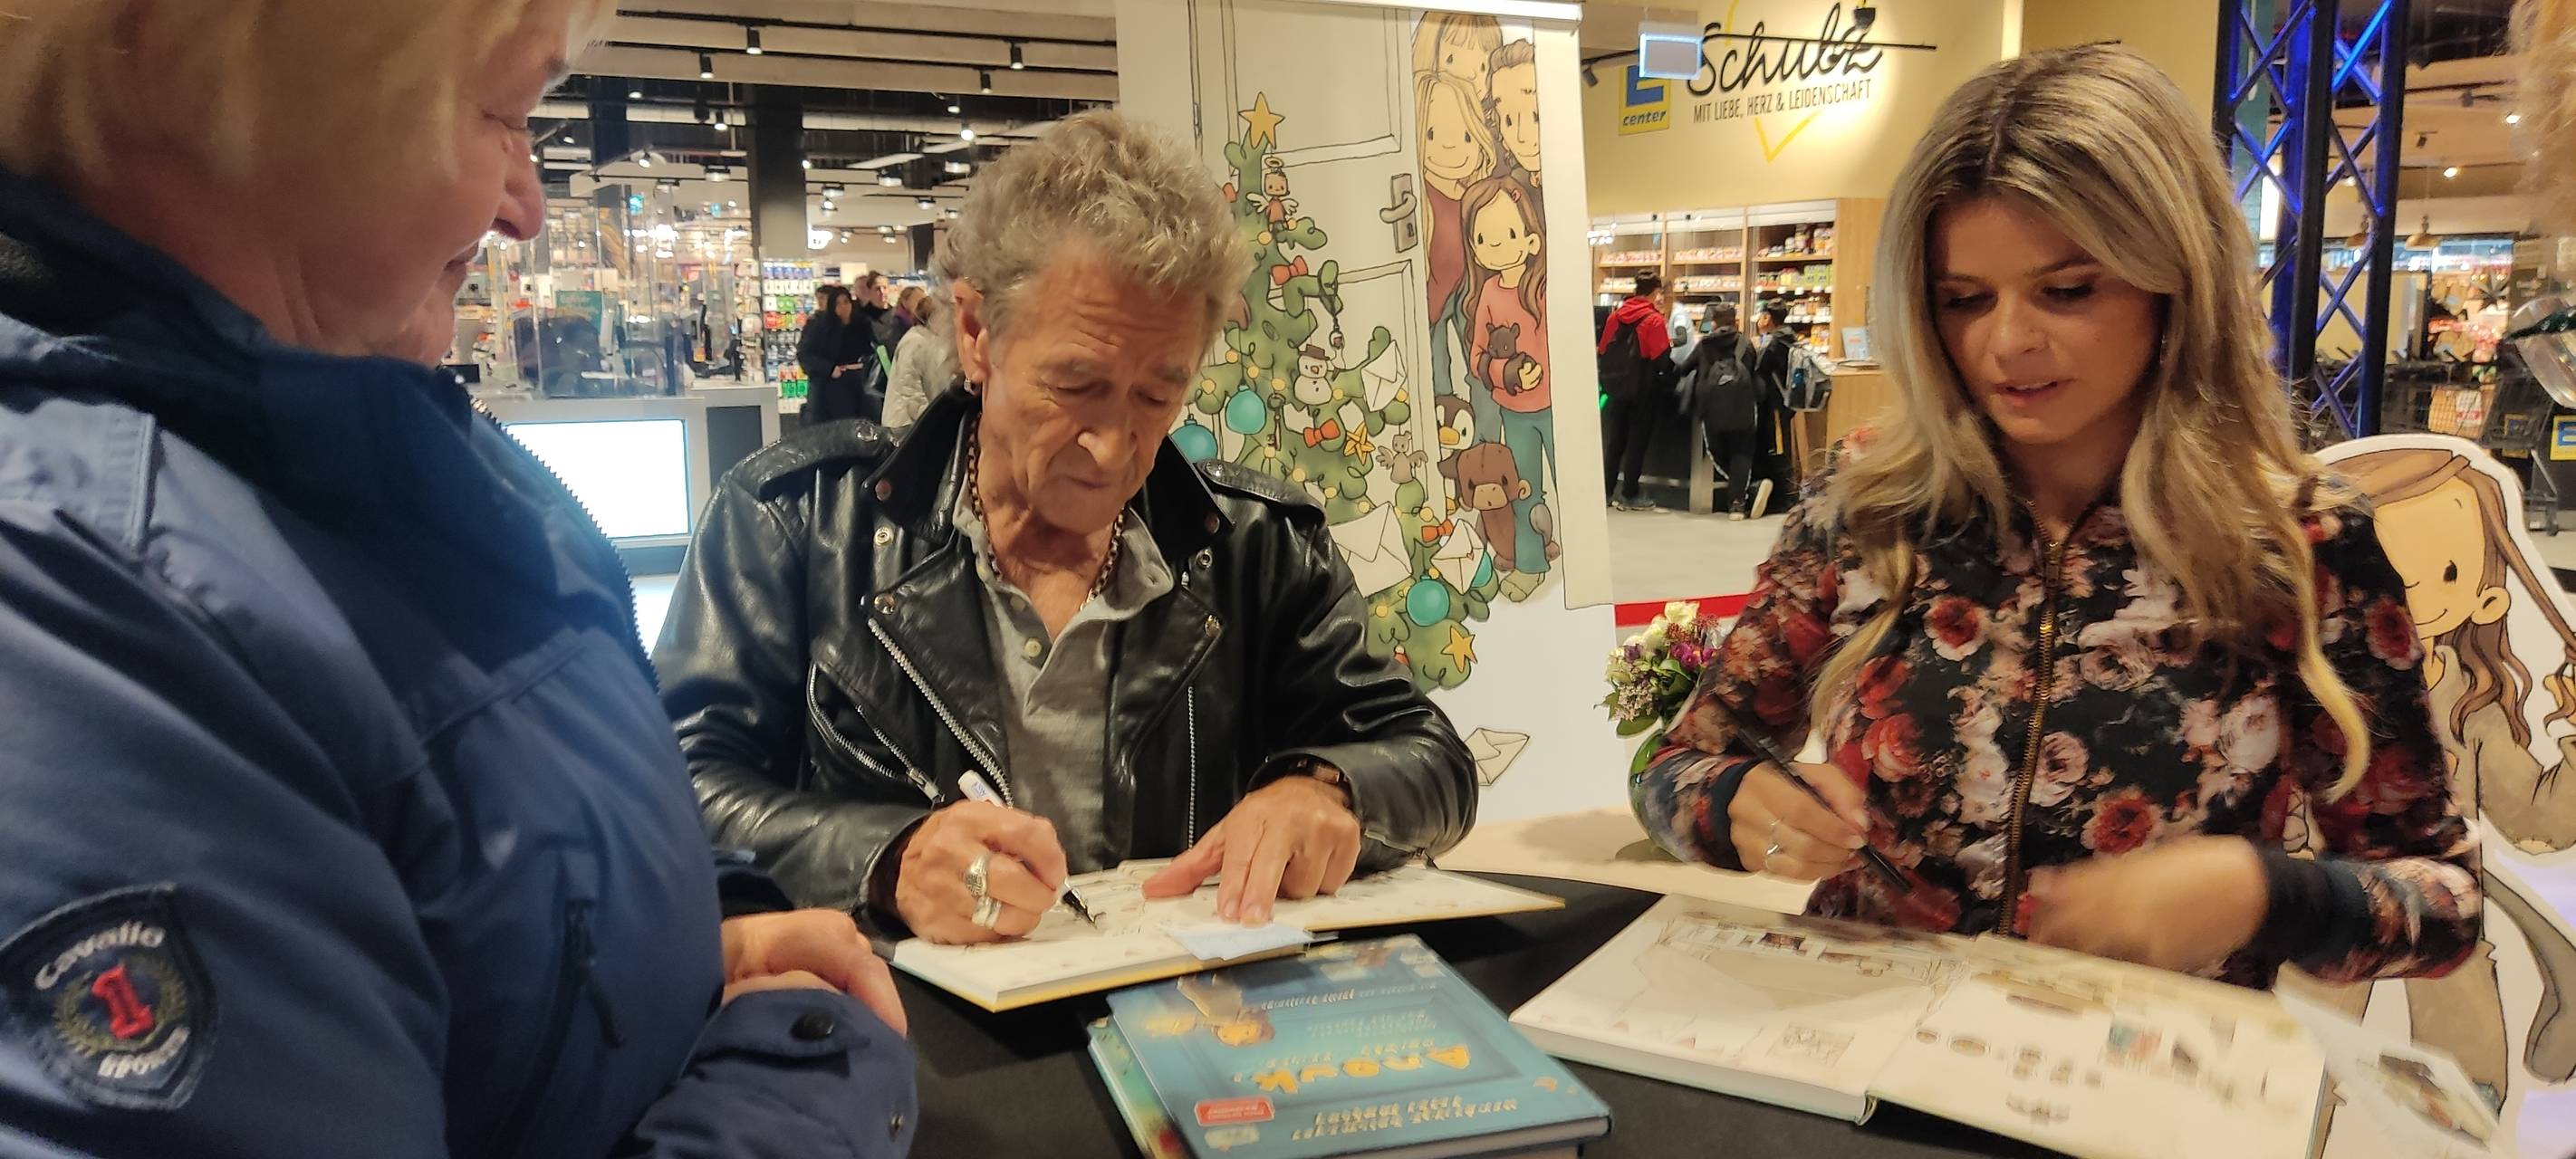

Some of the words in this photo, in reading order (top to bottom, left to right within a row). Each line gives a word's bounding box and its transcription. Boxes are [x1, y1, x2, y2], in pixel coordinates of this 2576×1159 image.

[1622, 110, 1667, 127] center
[1694, 102, 1712, 123] MIT
[1715, 98, 1744, 120] LIEBE,
[1747, 93, 1773, 116] HERZ
[1776, 92, 1784, 111] &
[1789, 79, 1871, 110] LEIDENSCHAFT
[34, 920, 166, 990] Cavallo
